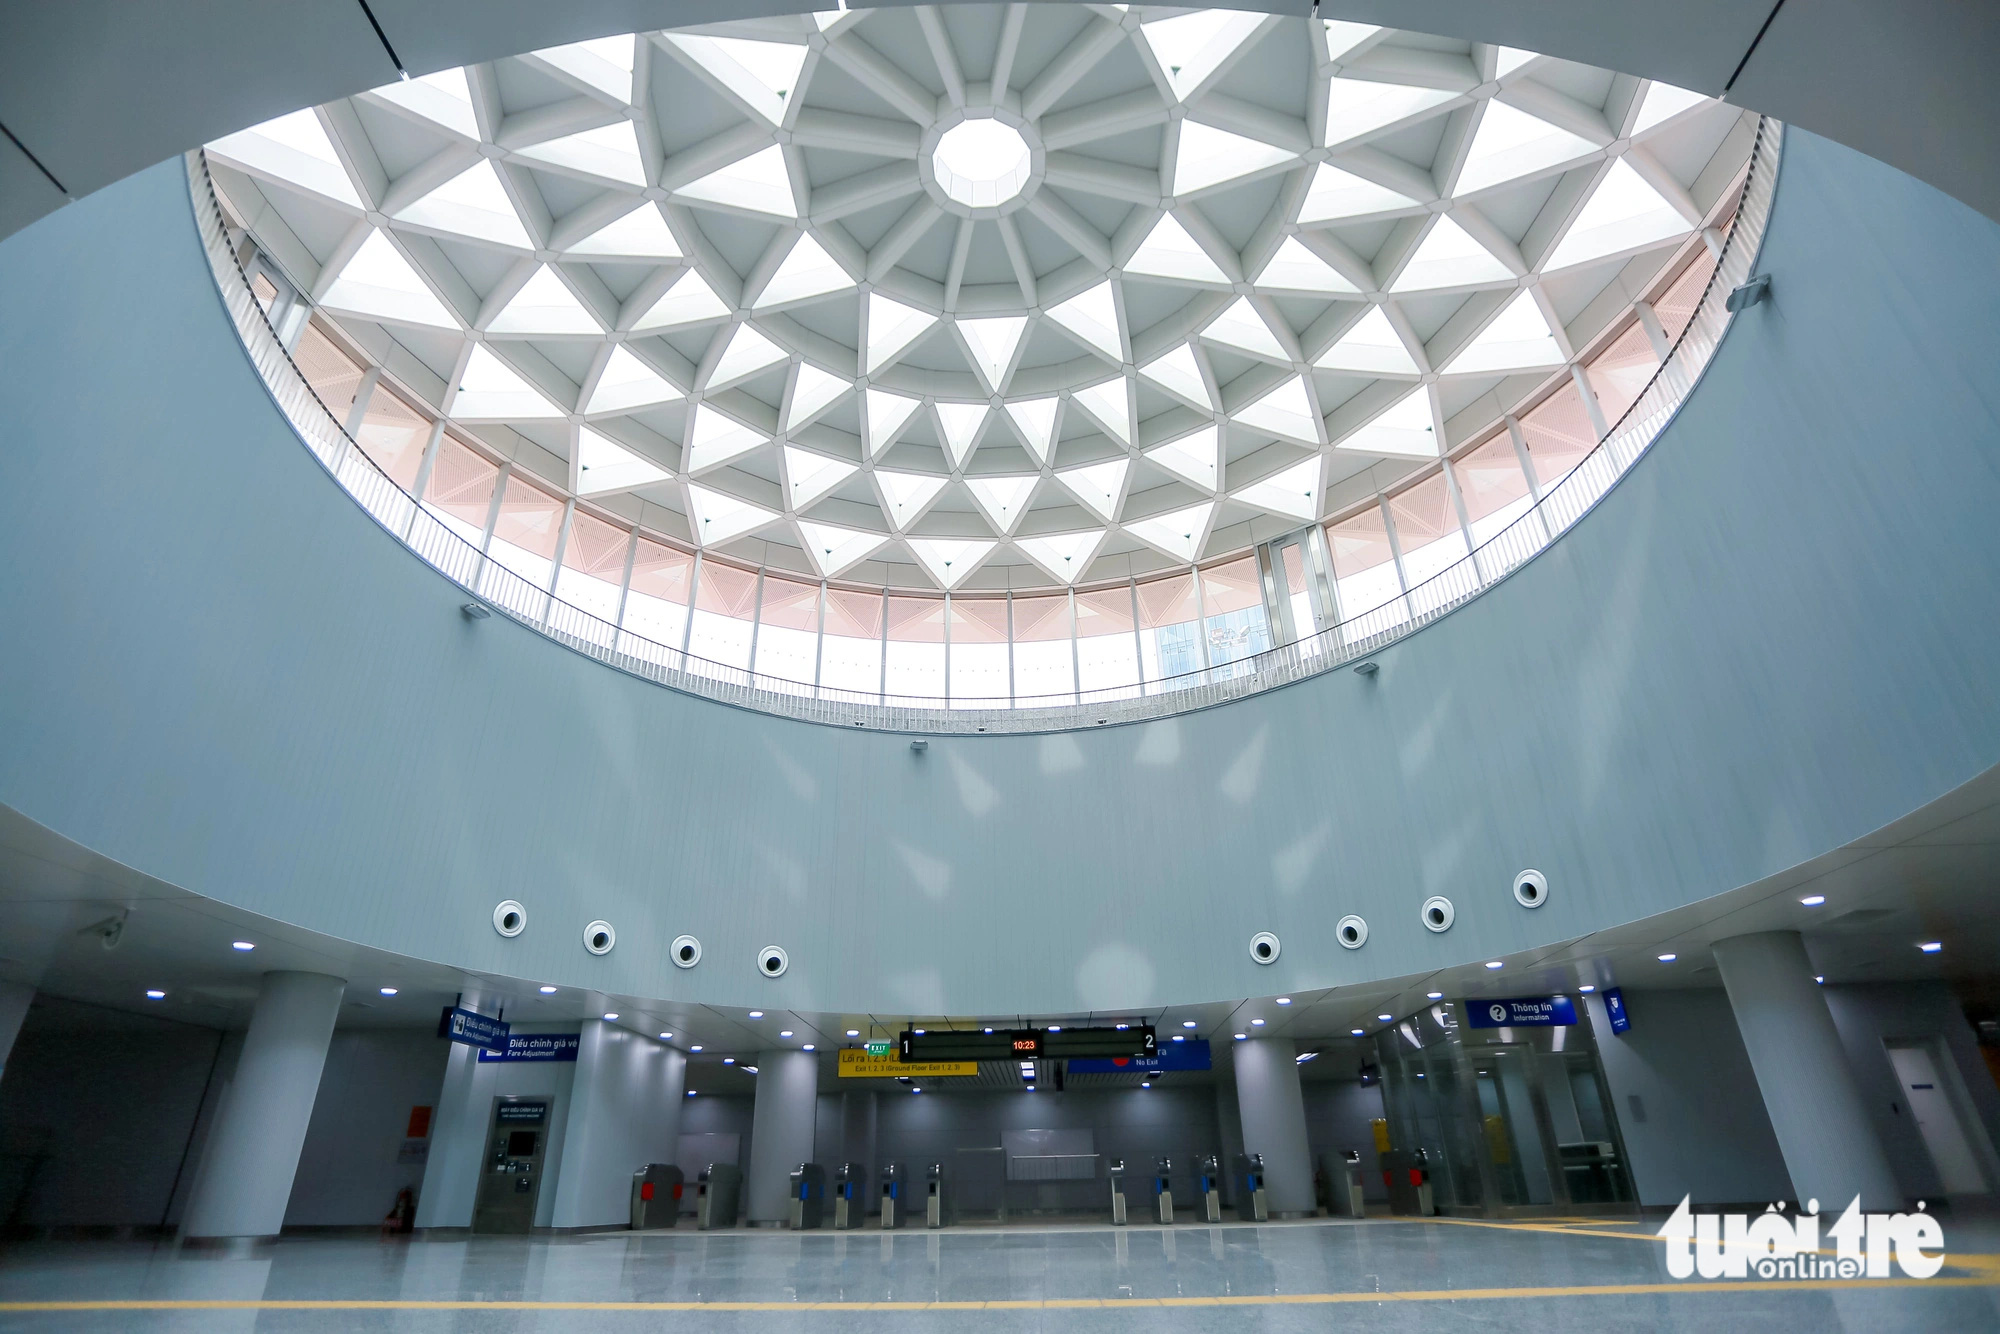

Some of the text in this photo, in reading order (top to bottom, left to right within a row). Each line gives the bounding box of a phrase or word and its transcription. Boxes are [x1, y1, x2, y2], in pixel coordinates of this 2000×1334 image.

[1511, 1002, 1553, 1014] Thông tin
[1013, 1040, 1035, 1050] 10:23
[1145, 1034, 1154, 1048] 2
[903, 1040, 909, 1054] 1
[521, 1050, 556, 1058] Adjustment
[1147, 1058, 1158, 1066] Exit
